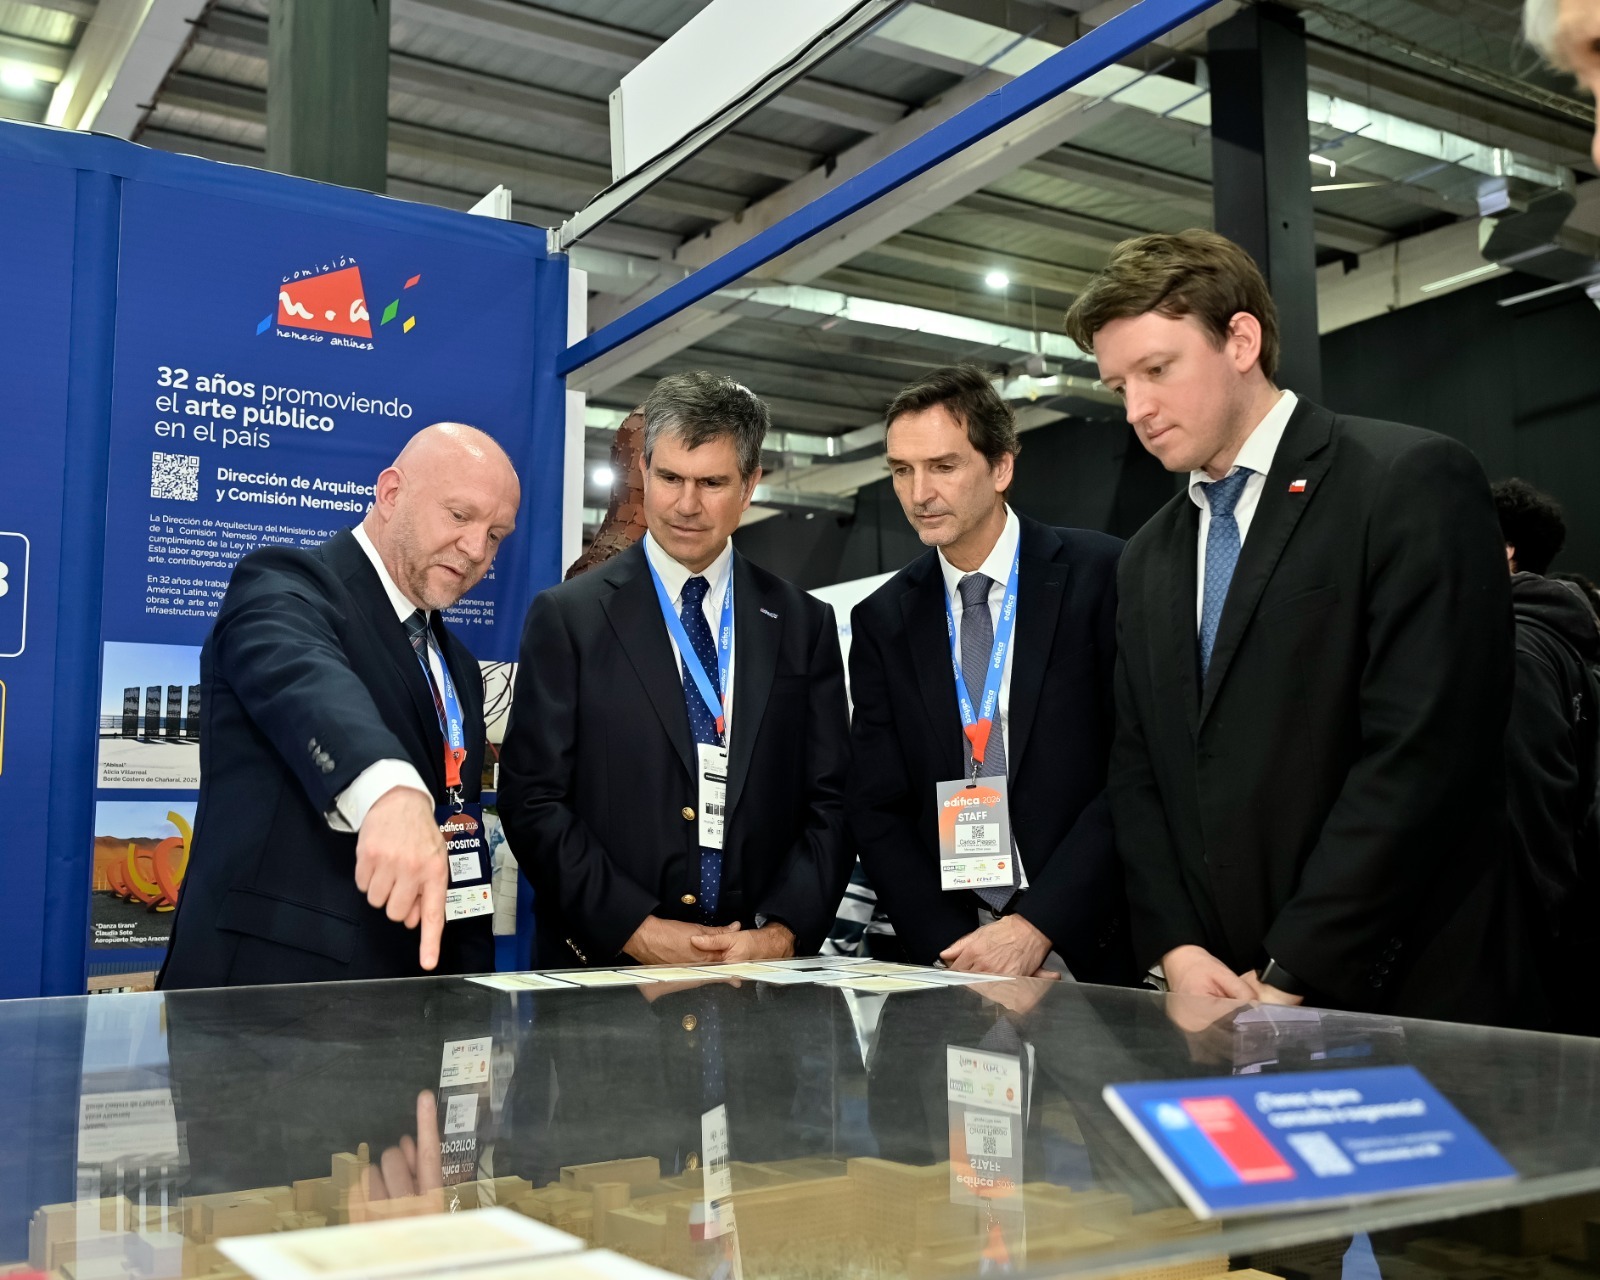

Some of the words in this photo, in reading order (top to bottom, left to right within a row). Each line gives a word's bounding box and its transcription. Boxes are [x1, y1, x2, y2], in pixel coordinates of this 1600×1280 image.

[282, 255, 356, 282] comisión
[276, 328, 323, 343] nemesio
[330, 337, 374, 350] antúnez
[157, 366, 189, 389] 32
[195, 373, 255, 398] años
[262, 384, 413, 418] promoviendo
[155, 392, 179, 413] el
[184, 398, 237, 419] arte
[243, 404, 335, 431] público
[154, 420, 185, 438] en
[193, 421, 216, 442] el
[222, 427, 270, 448] país
[217, 467, 288, 487] Dirección
[290, 475, 310, 489] de
[312, 478, 376, 495] Arquitect
[216, 489, 225, 502] y
[228, 487, 297, 506] Comisión
[301, 495, 363, 513] Nemesio
[149, 524, 160, 532] de
[166, 525, 173, 533] la
[179, 527, 216, 537] Comisión
[222, 530, 257, 541] Nemesio
[150, 513, 160, 522] La
[162, 515, 200, 525] Dirección
[215, 520, 263, 531] Arquitectura
[265, 524, 278, 532] del
[279, 526, 315, 536] Ministerio
[148, 535, 205, 547] cumplimiento
[220, 540, 228, 548] la
[229, 541, 244, 551] Ley
[148, 544, 166, 553] Esta
[168, 546, 189, 555] labor
[191, 549, 219, 559] agrega
[220, 551, 240, 559] valor
[168, 557, 227, 568] contribuyendo
[146, 585, 180, 595] América
[147, 575, 158, 583] En
[159, 576, 170, 584] 32
[171, 577, 191, 585] años
[192, 579, 203, 587] de
[204, 580, 229, 589] trabaj
[145, 596, 169, 604] obras
[173, 597, 184, 605] de
[188, 599, 204, 607] arte
[1003, 594, 1015, 621] edifica
[145, 606, 205, 617] infraestructura
[994, 641, 1004, 669] edifica
[984, 689, 994, 717] edifica
[943, 796, 980, 808] edifica
[982, 795, 1000, 804] 2026
[958, 811, 987, 822] STAFF
[446, 838, 480, 850] XPOSITOR
